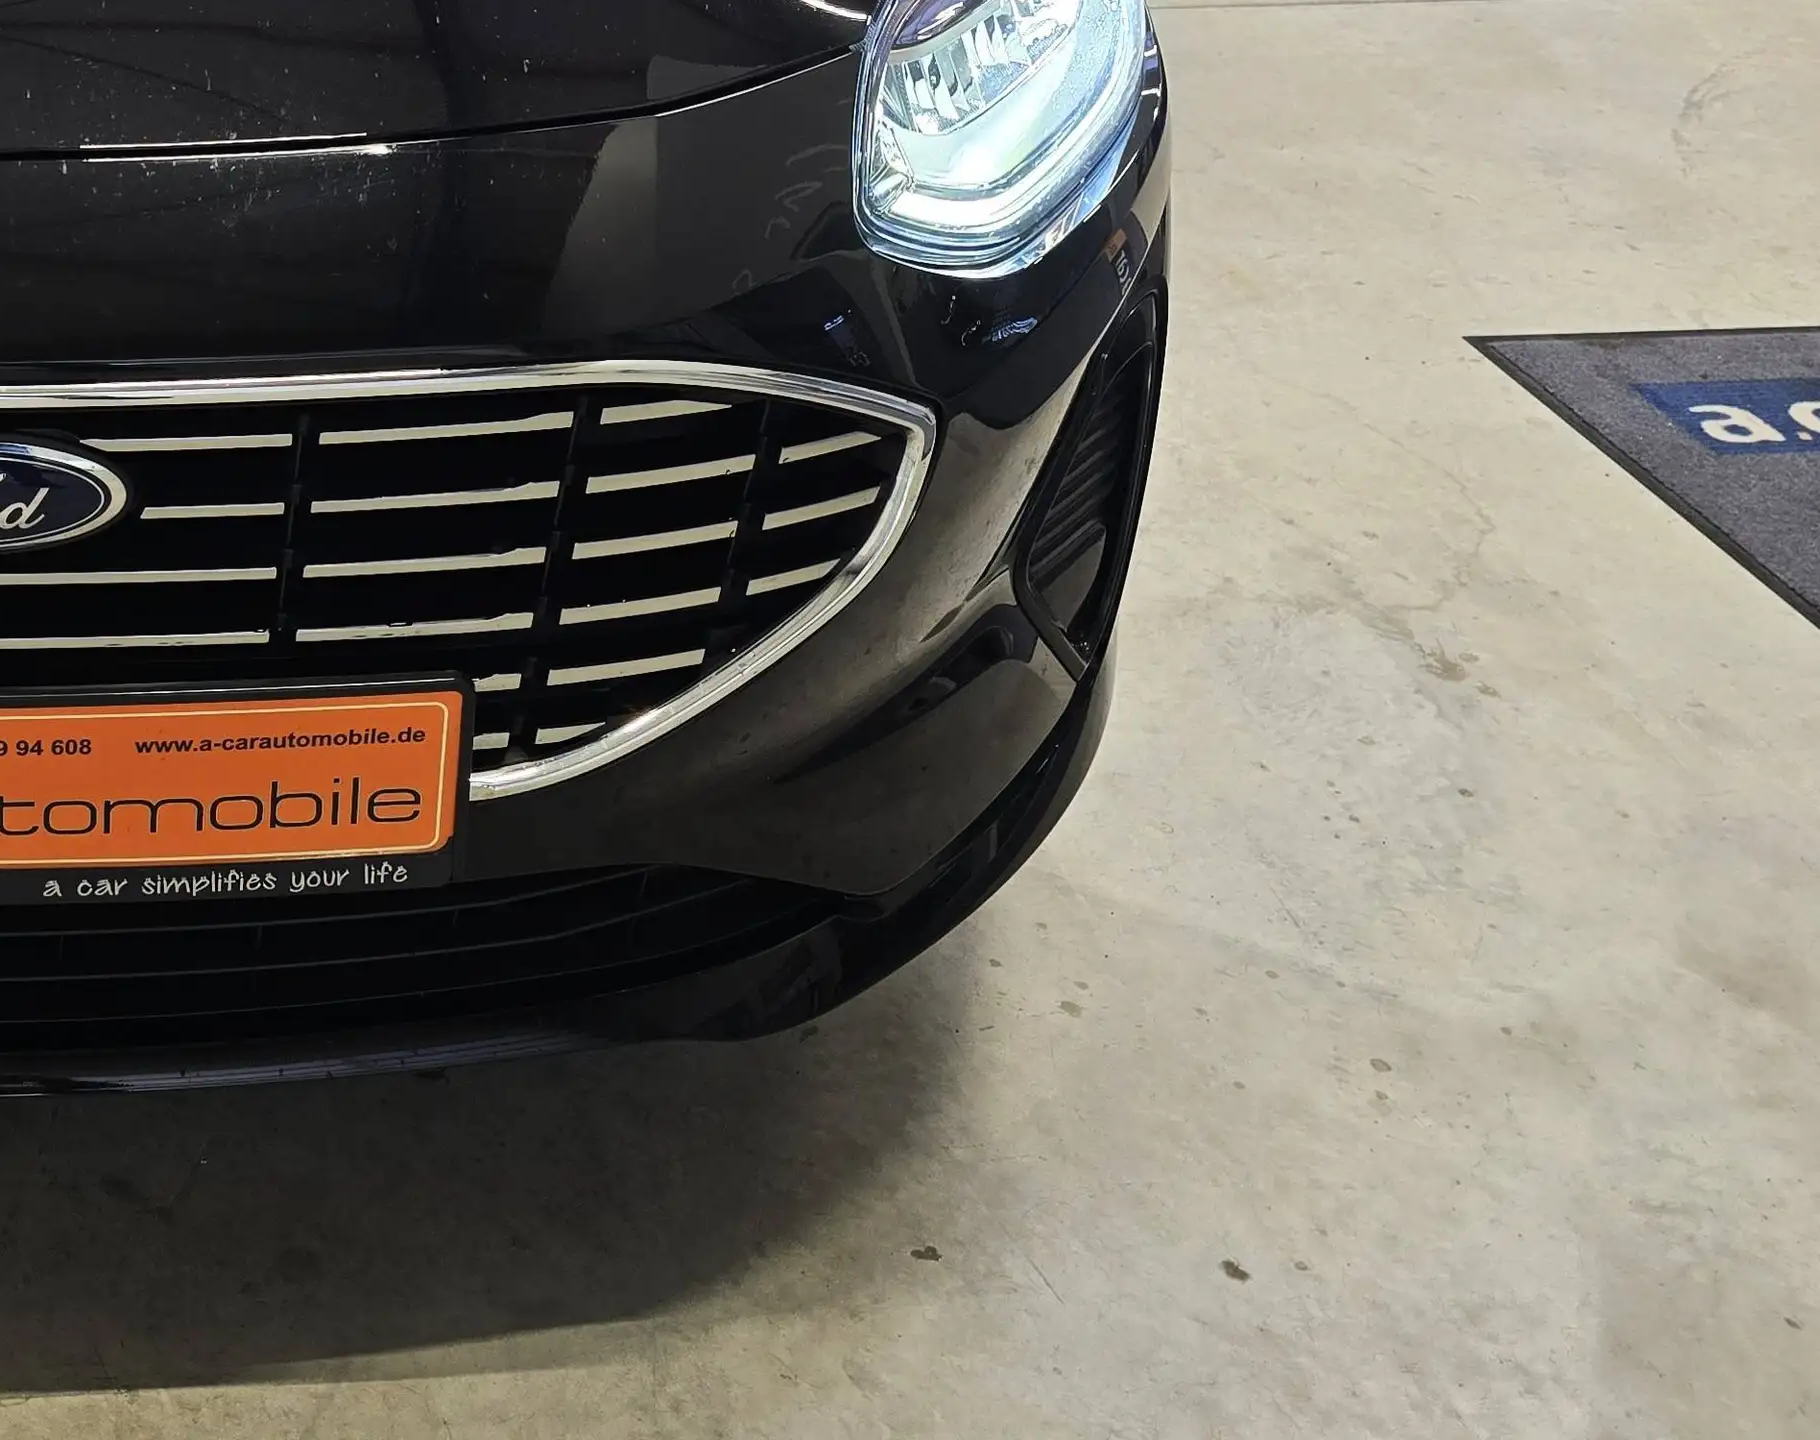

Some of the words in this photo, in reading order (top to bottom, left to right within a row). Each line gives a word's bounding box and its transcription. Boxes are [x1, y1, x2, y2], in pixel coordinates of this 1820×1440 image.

[16, 739, 44, 756] 94
[51, 739, 92, 756] 608
[134, 726, 426, 754] www.a-carautomobile.de
[43, 879, 62, 898] a
[76, 876, 127, 898] car
[140, 867, 277, 897] simplifies
[290, 868, 350, 892] your
[363, 861, 409, 885] life
